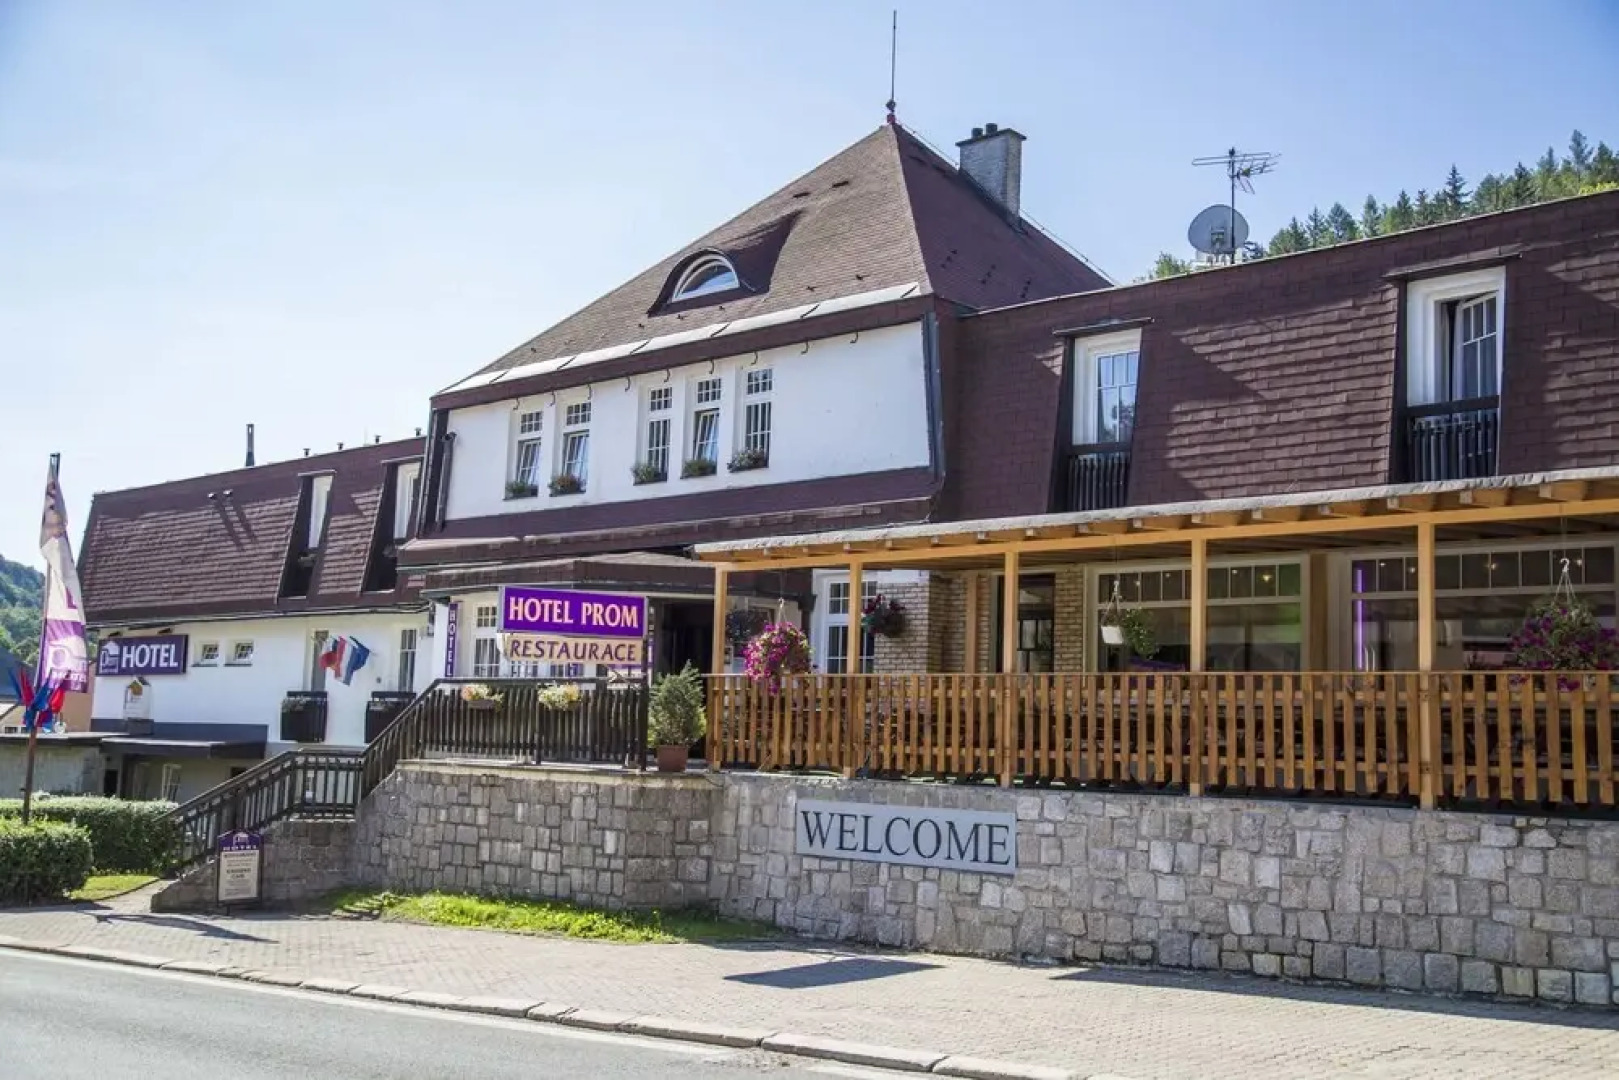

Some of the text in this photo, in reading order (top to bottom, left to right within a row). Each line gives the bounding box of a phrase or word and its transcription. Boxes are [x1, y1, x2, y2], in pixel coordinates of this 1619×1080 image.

[508, 596, 639, 628] HOTEL PROM
[121, 643, 179, 668] HOTEL
[446, 609, 456, 676] HOTEL
[509, 639, 637, 662] RESTAURACE
[801, 810, 1011, 866] WELCOME
